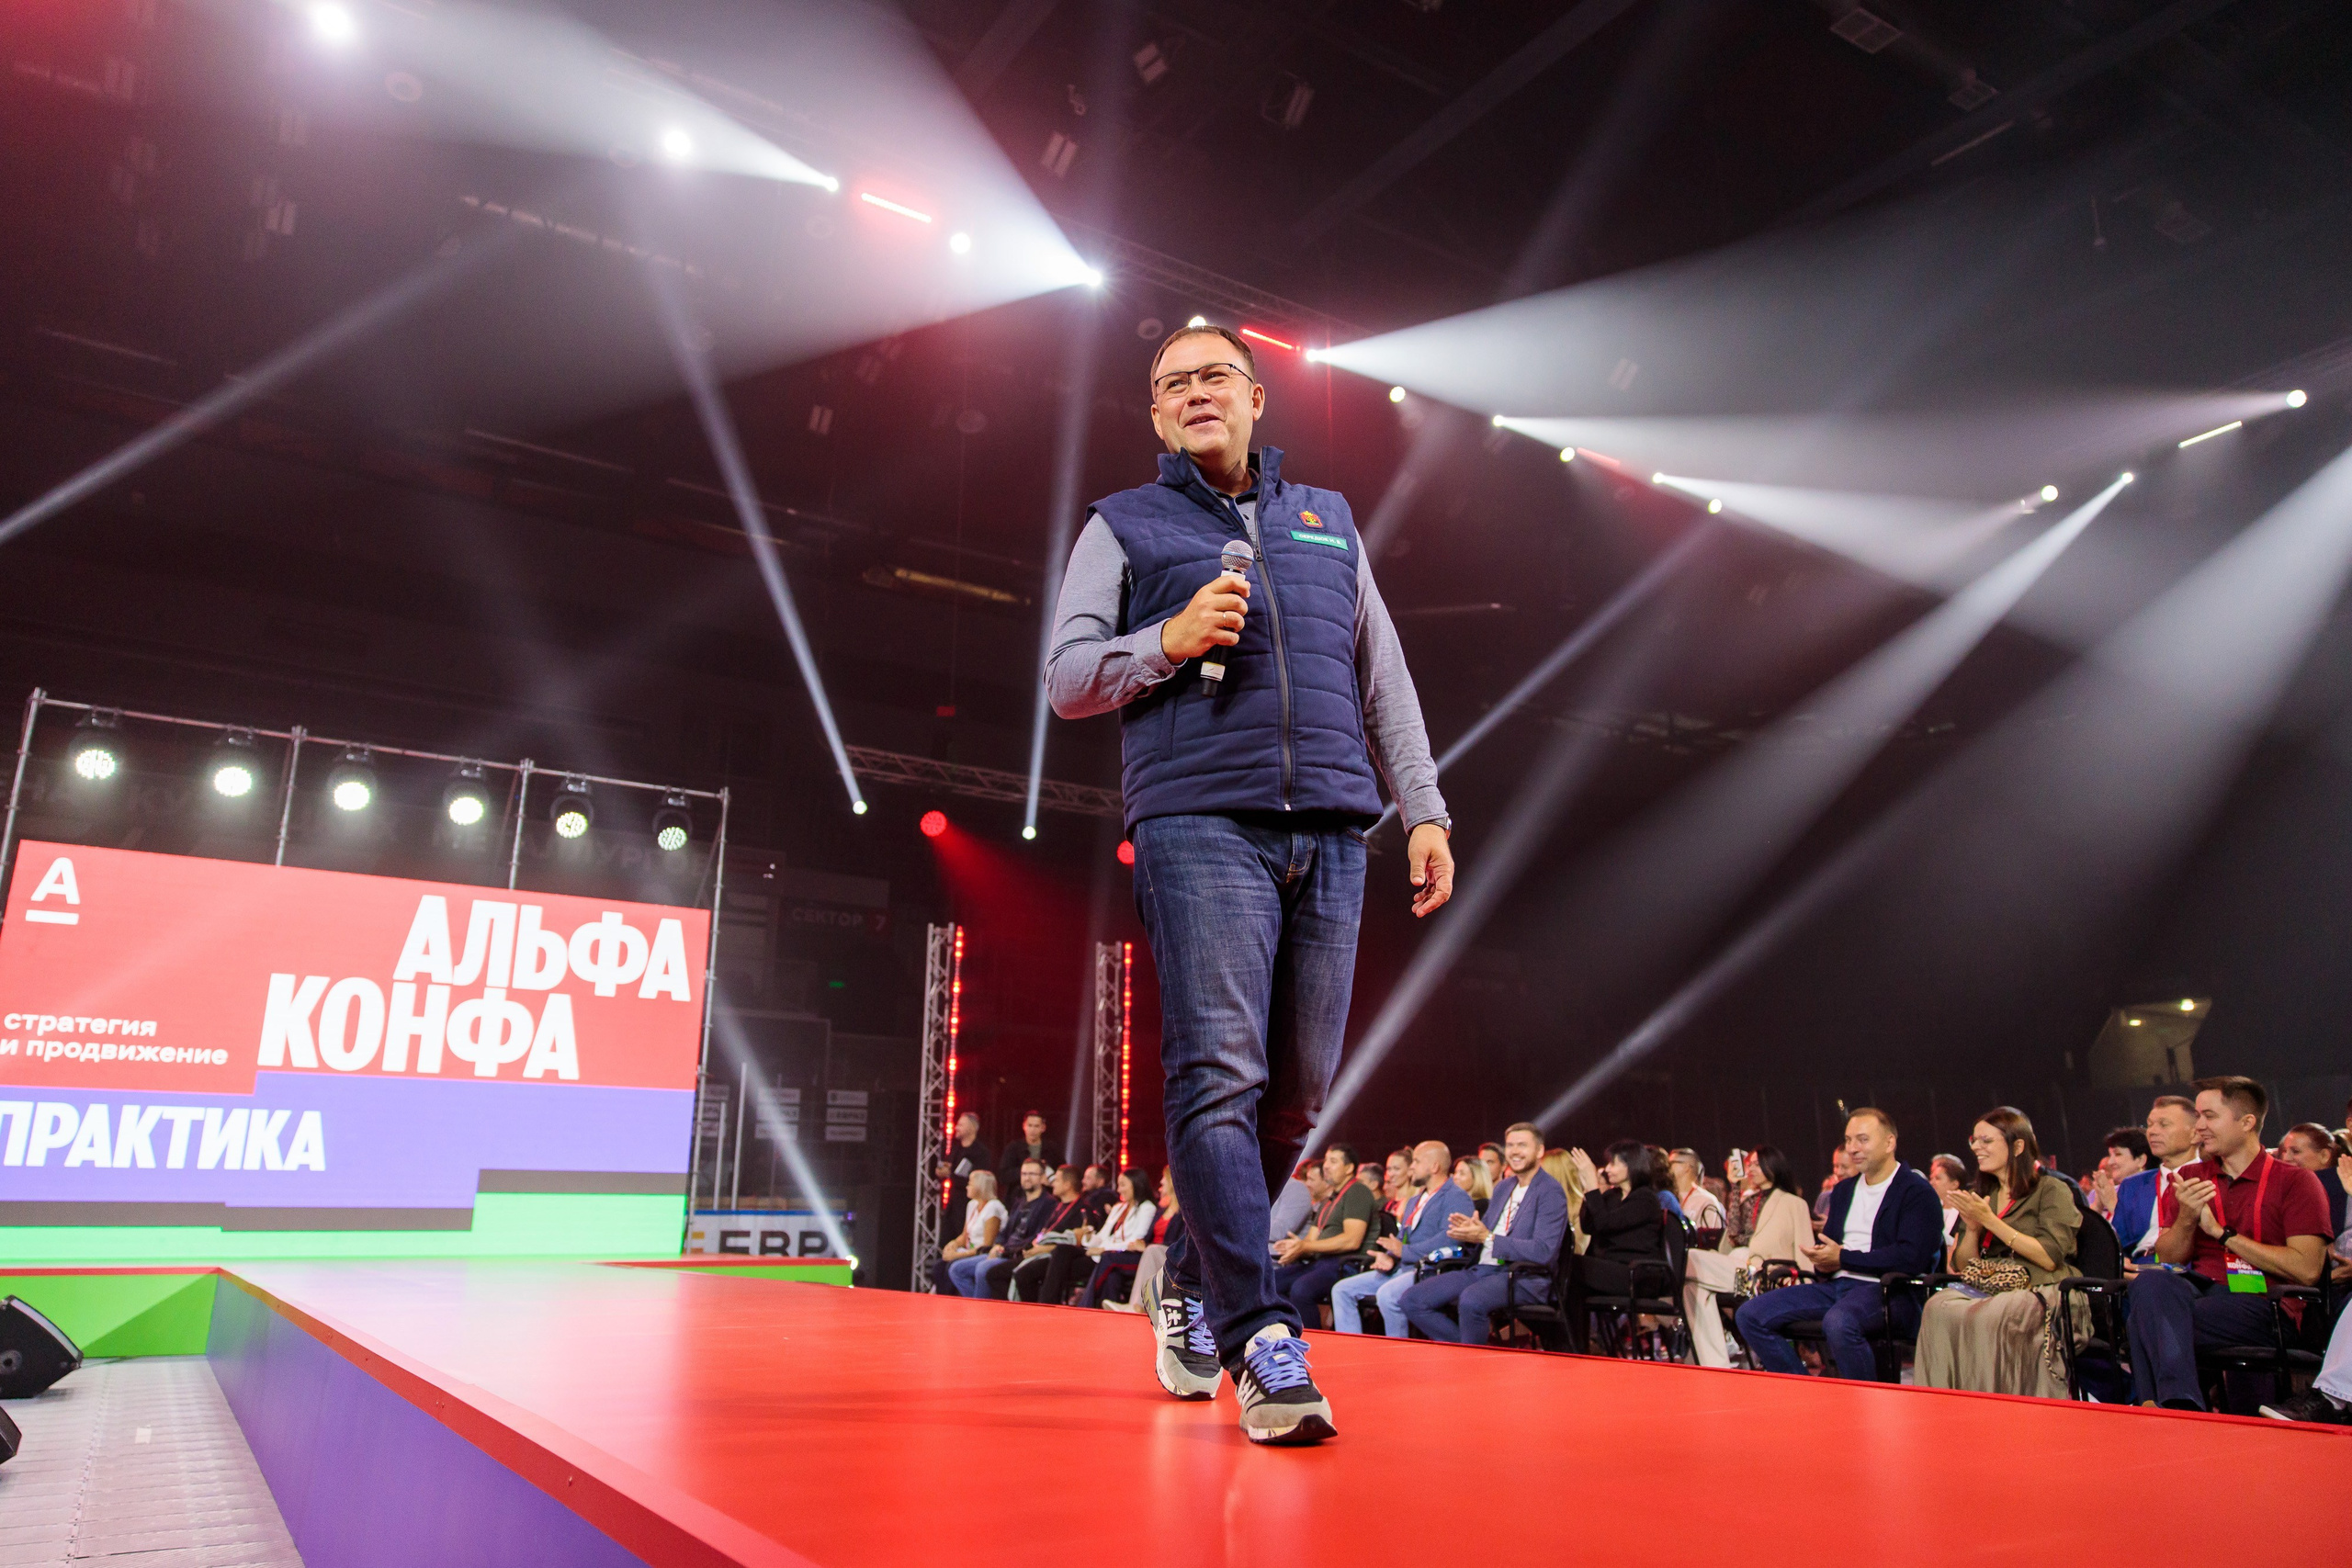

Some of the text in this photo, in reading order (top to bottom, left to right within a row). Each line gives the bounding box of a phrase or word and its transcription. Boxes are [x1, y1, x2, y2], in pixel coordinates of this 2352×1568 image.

[30, 857, 81, 905] А
[792, 908, 887, 931] СЕКТОР 7
[392, 895, 691, 1003] АЛЬФА
[4, 1012, 158, 1037] стратегия
[256, 973, 580, 1080] КОНФА
[0, 1038, 229, 1066] и продвижение
[0, 1100, 326, 1171] ПРАКТИКА
[718, 1230, 838, 1258] ЕВР
